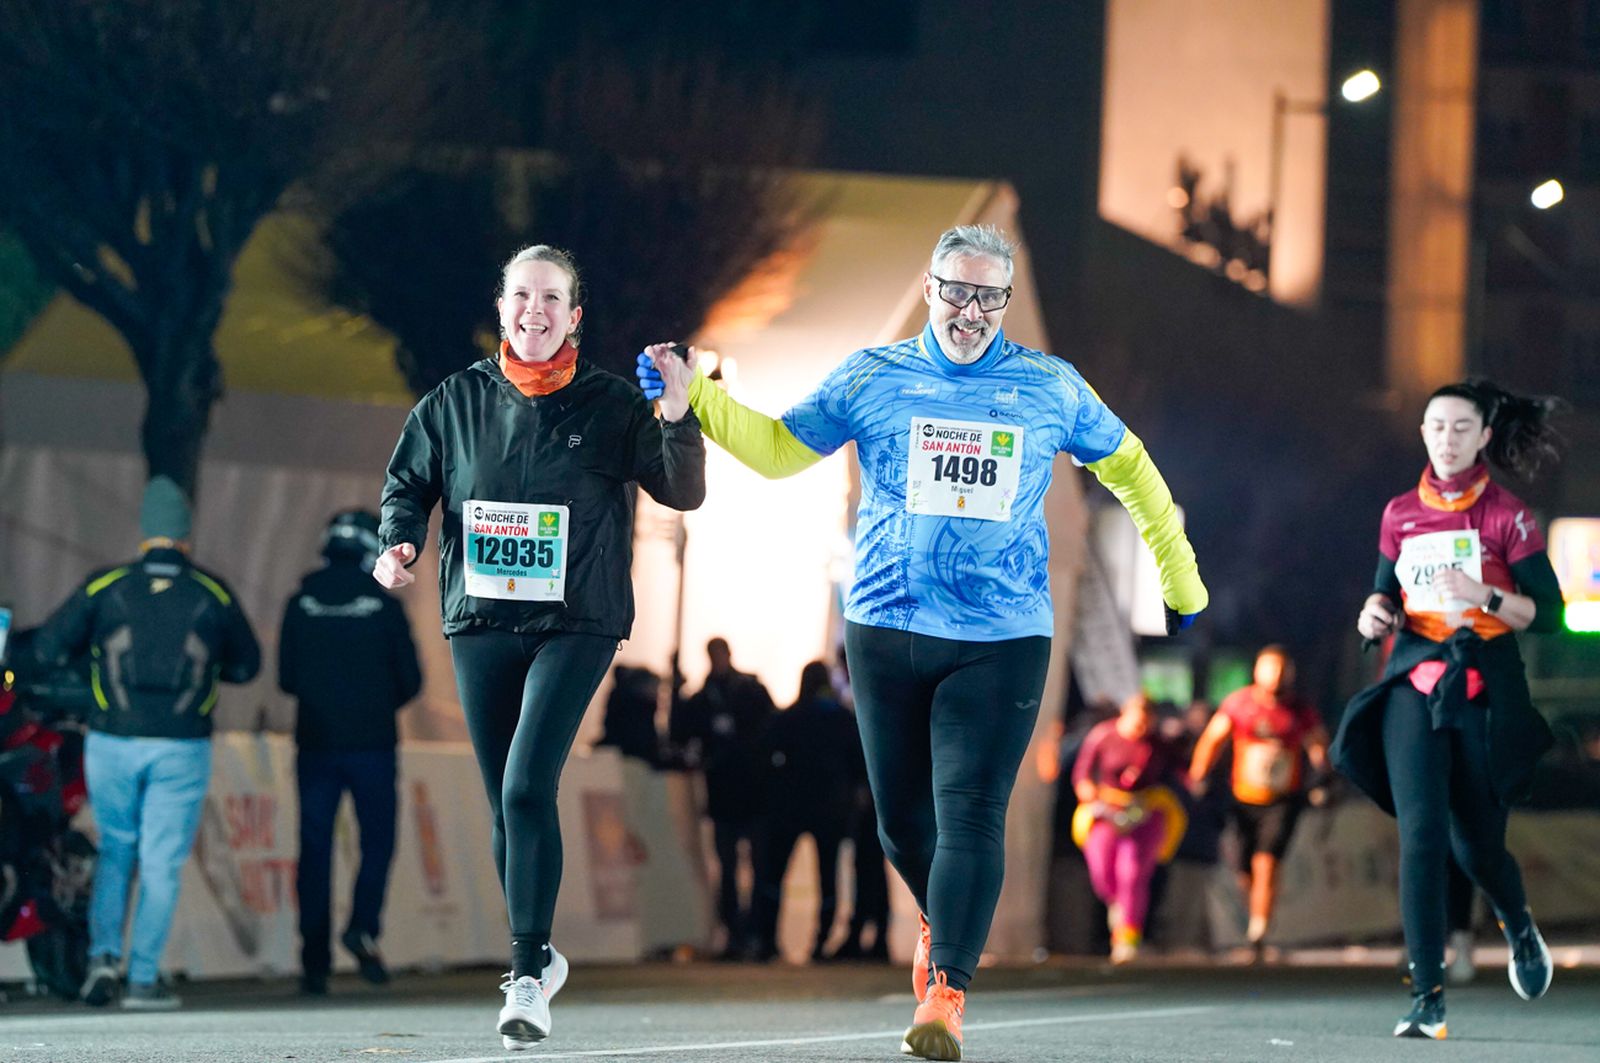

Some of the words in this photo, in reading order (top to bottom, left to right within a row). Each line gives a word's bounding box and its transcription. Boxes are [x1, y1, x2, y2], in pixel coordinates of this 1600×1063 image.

[936, 430, 968, 441] NOCHE
[969, 432, 982, 443] DE
[922, 439, 944, 451] SAN
[945, 440, 981, 455] ANTÓN
[931, 454, 998, 487] 1498
[951, 485, 974, 494] Miguel
[485, 513, 515, 524] NOCHE
[516, 515, 529, 524] DE
[474, 523, 492, 535] SAN
[493, 523, 529, 537] ANTÓN
[474, 536, 553, 568] 12935
[497, 567, 527, 577] Mercedes
